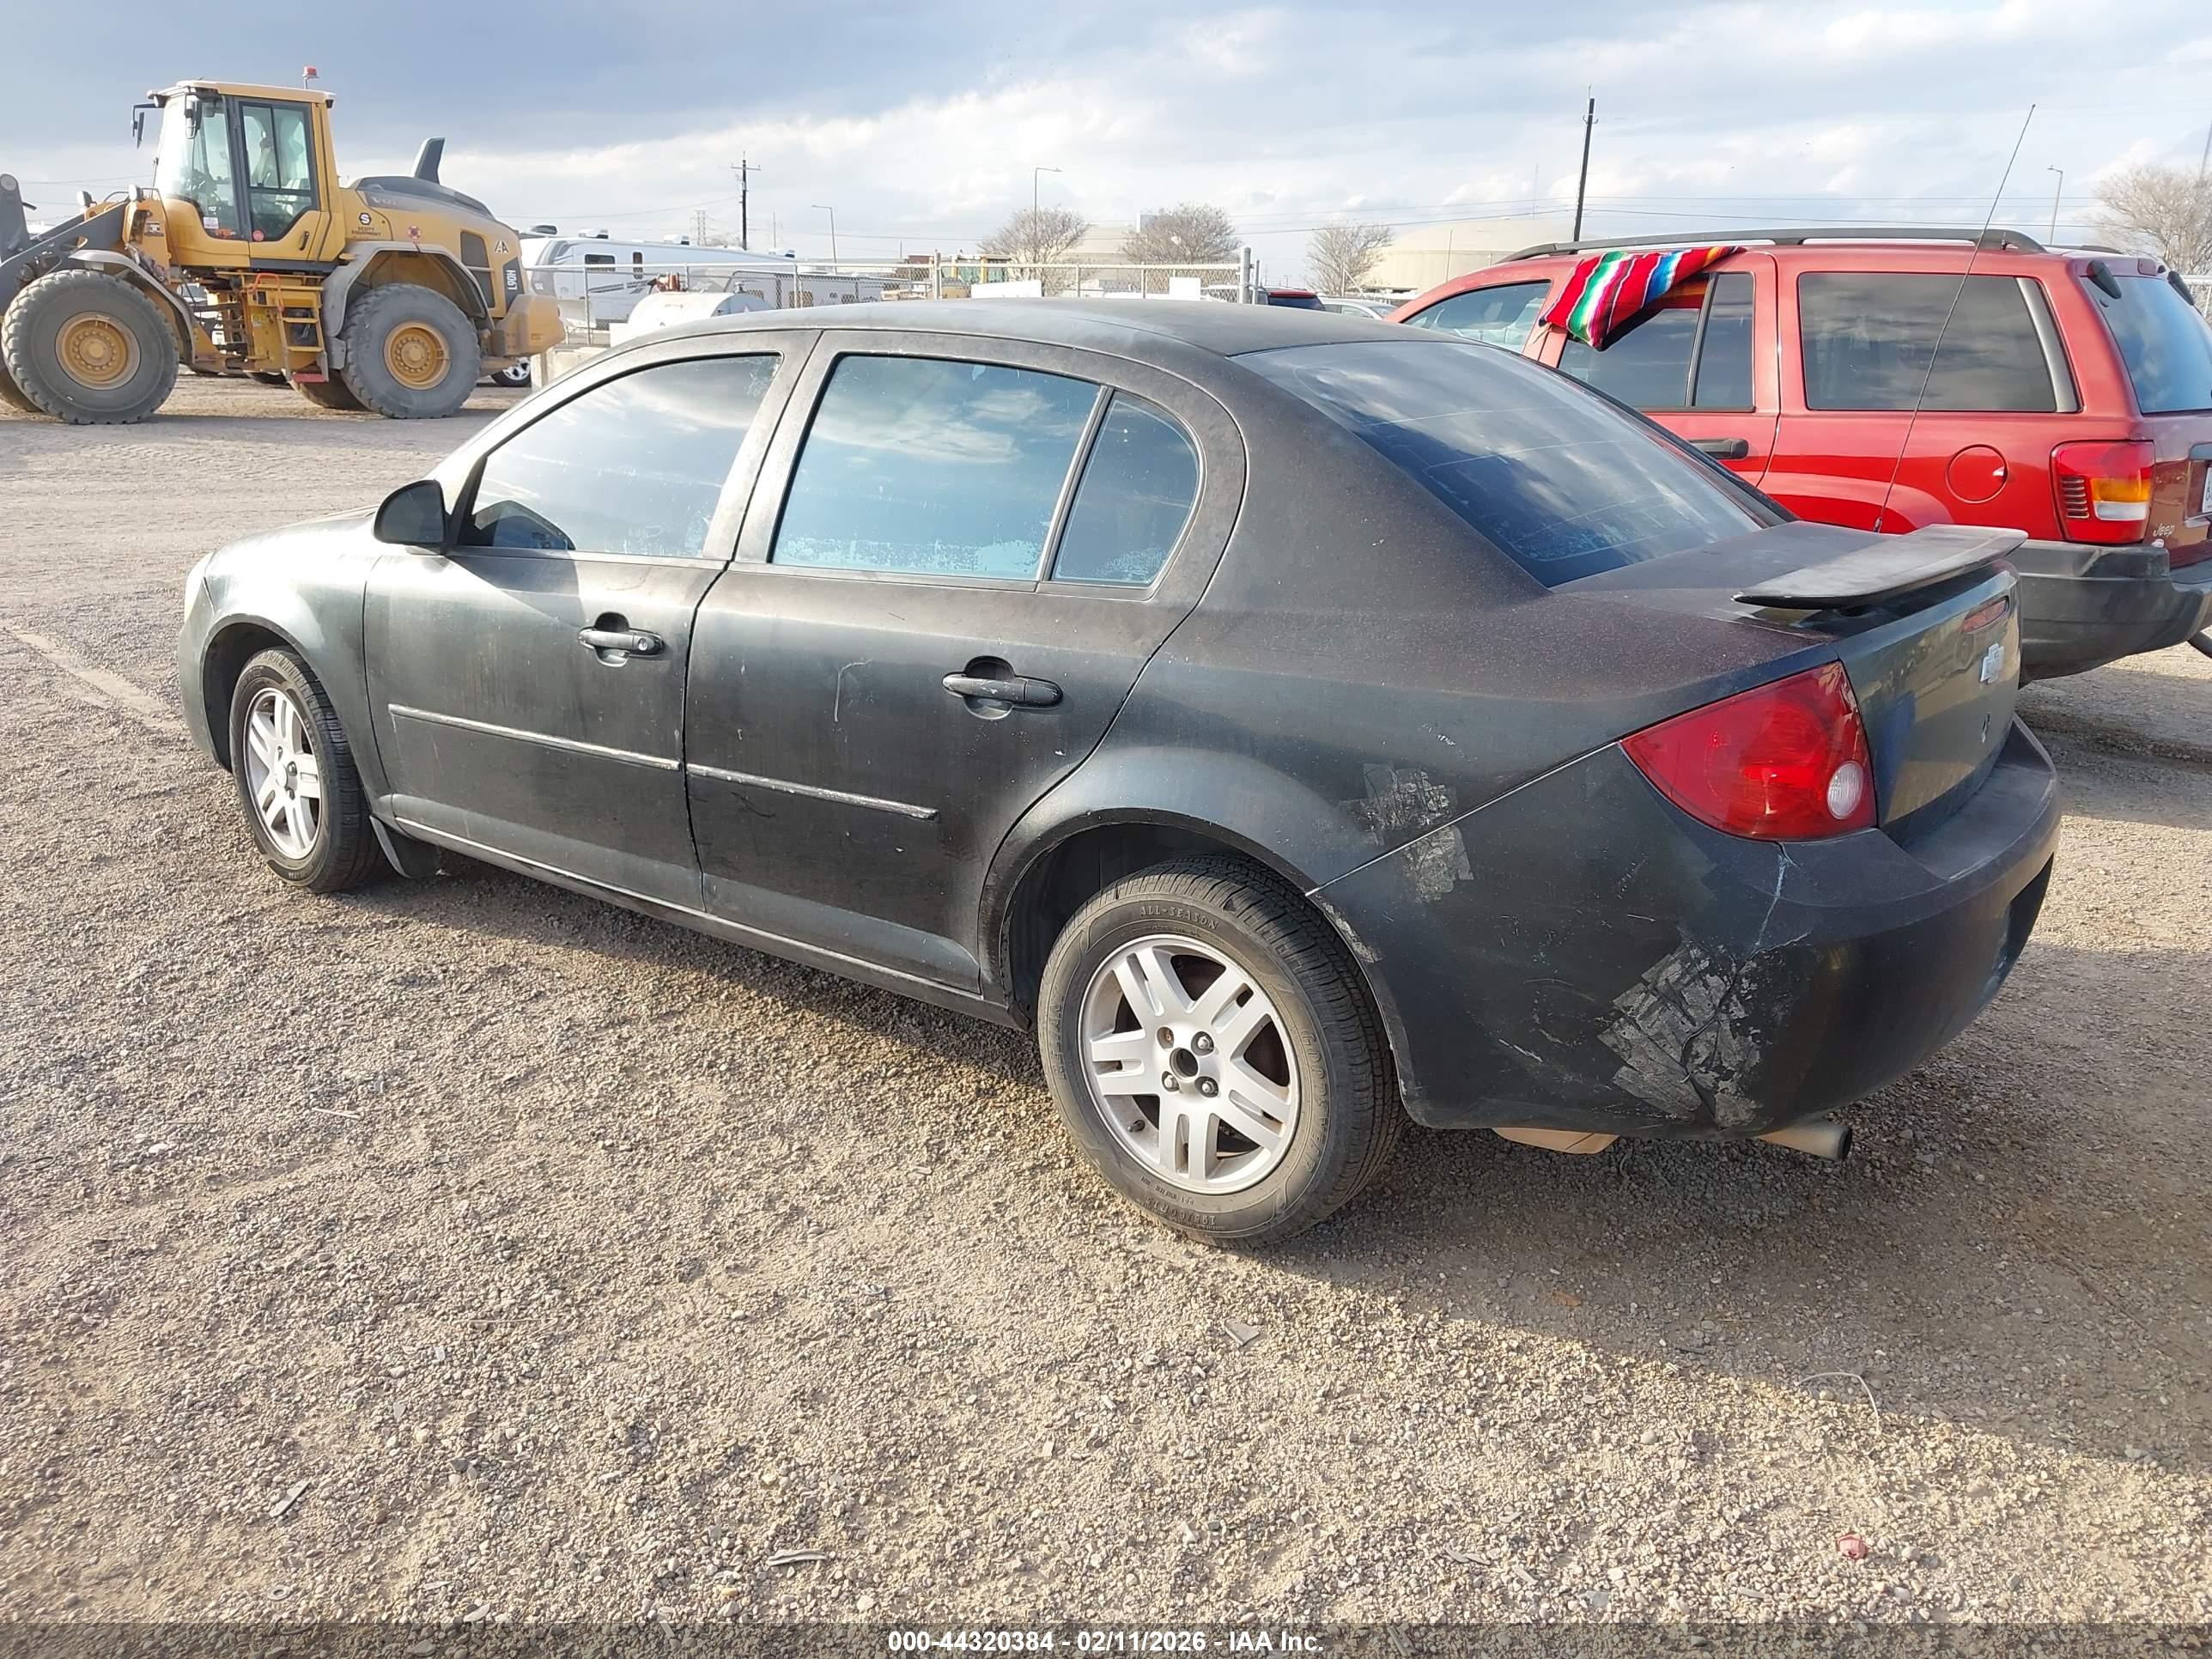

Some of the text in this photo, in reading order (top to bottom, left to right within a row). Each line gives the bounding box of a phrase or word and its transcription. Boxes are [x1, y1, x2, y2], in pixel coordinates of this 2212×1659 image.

[505, 269, 518, 290] L90H
[2153, 522, 2175, 537] Jeep
[1139, 905, 1218, 929] ALL-SEASON
